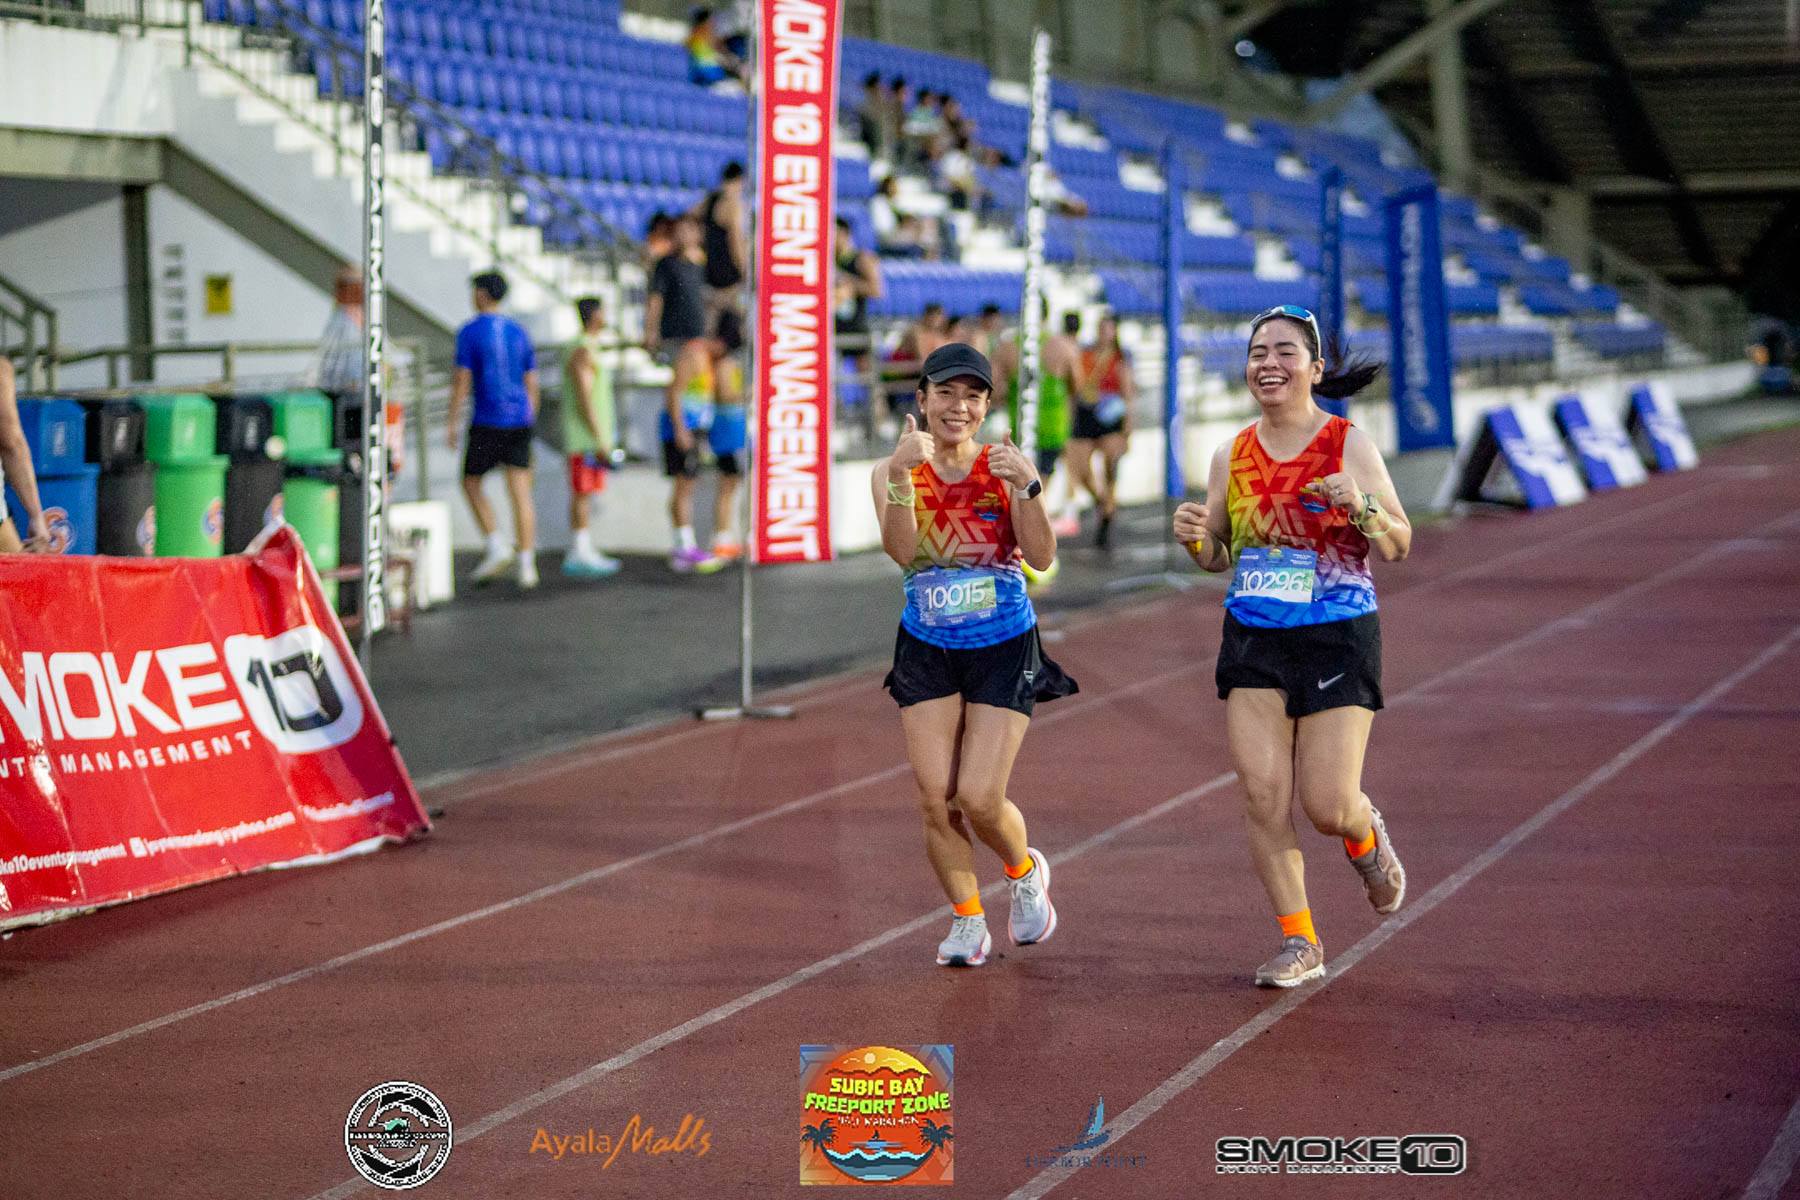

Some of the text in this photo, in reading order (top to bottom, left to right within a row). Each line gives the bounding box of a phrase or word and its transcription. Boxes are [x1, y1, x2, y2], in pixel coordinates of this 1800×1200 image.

[370, 75, 383, 127] 10
[772, 102, 823, 145] 10
[771, 153, 821, 286] EVENT
[767, 293, 820, 561] MANAGEMENT
[368, 411, 386, 633] TRADING
[925, 582, 986, 610] 10015
[1241, 570, 1306, 593] 10296
[60, 730, 251, 774] MANAGEMENT
